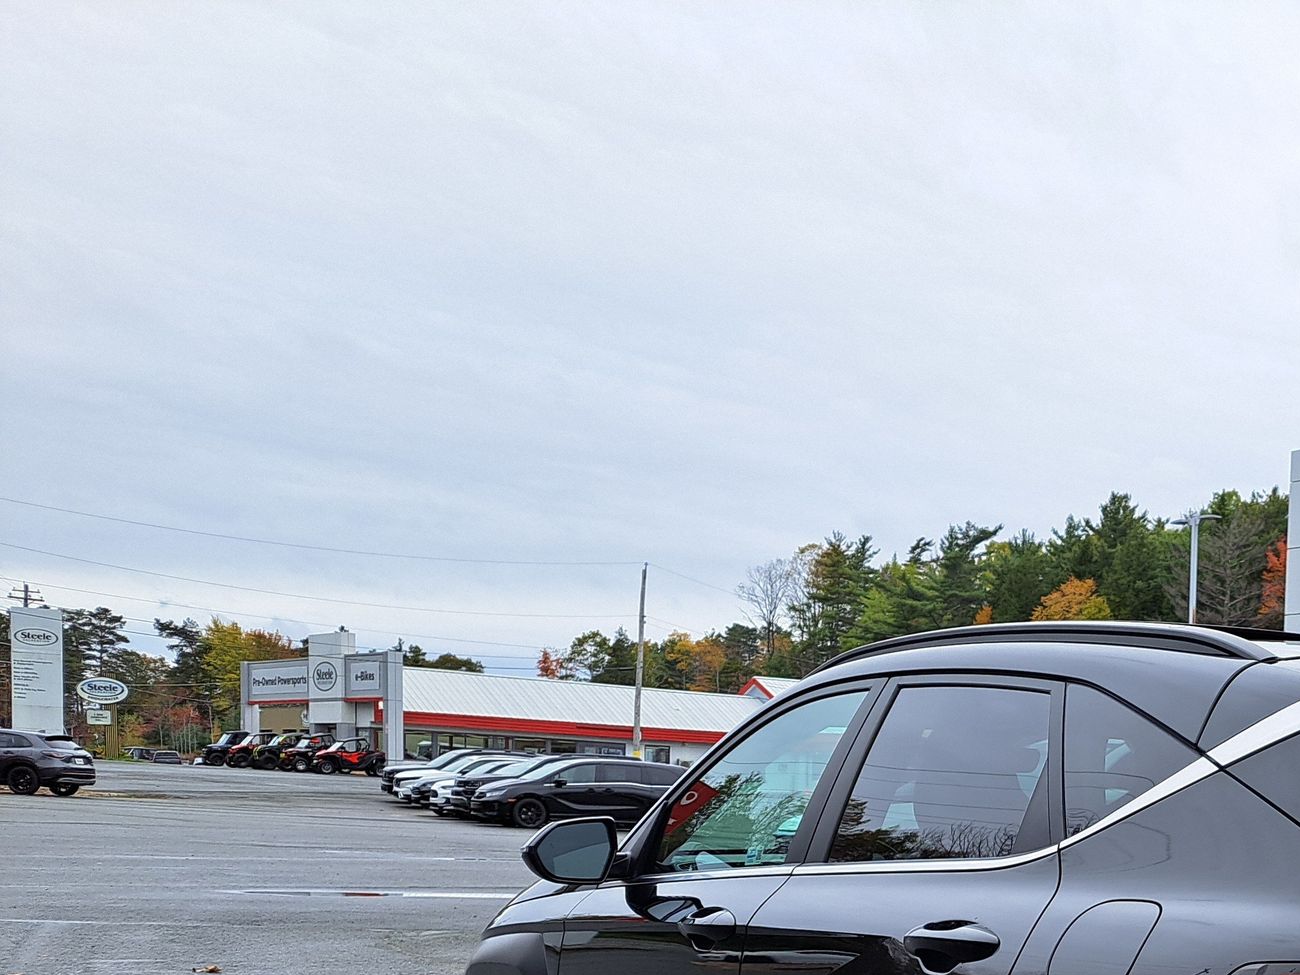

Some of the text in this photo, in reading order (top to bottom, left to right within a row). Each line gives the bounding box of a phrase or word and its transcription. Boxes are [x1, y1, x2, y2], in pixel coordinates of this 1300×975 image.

[20, 631, 52, 641] Steele
[316, 668, 334, 681] Steele
[354, 670, 375, 682] e-Bikes
[87, 682, 119, 693] Steele
[252, 675, 307, 688] Pre-Owned Powersports
